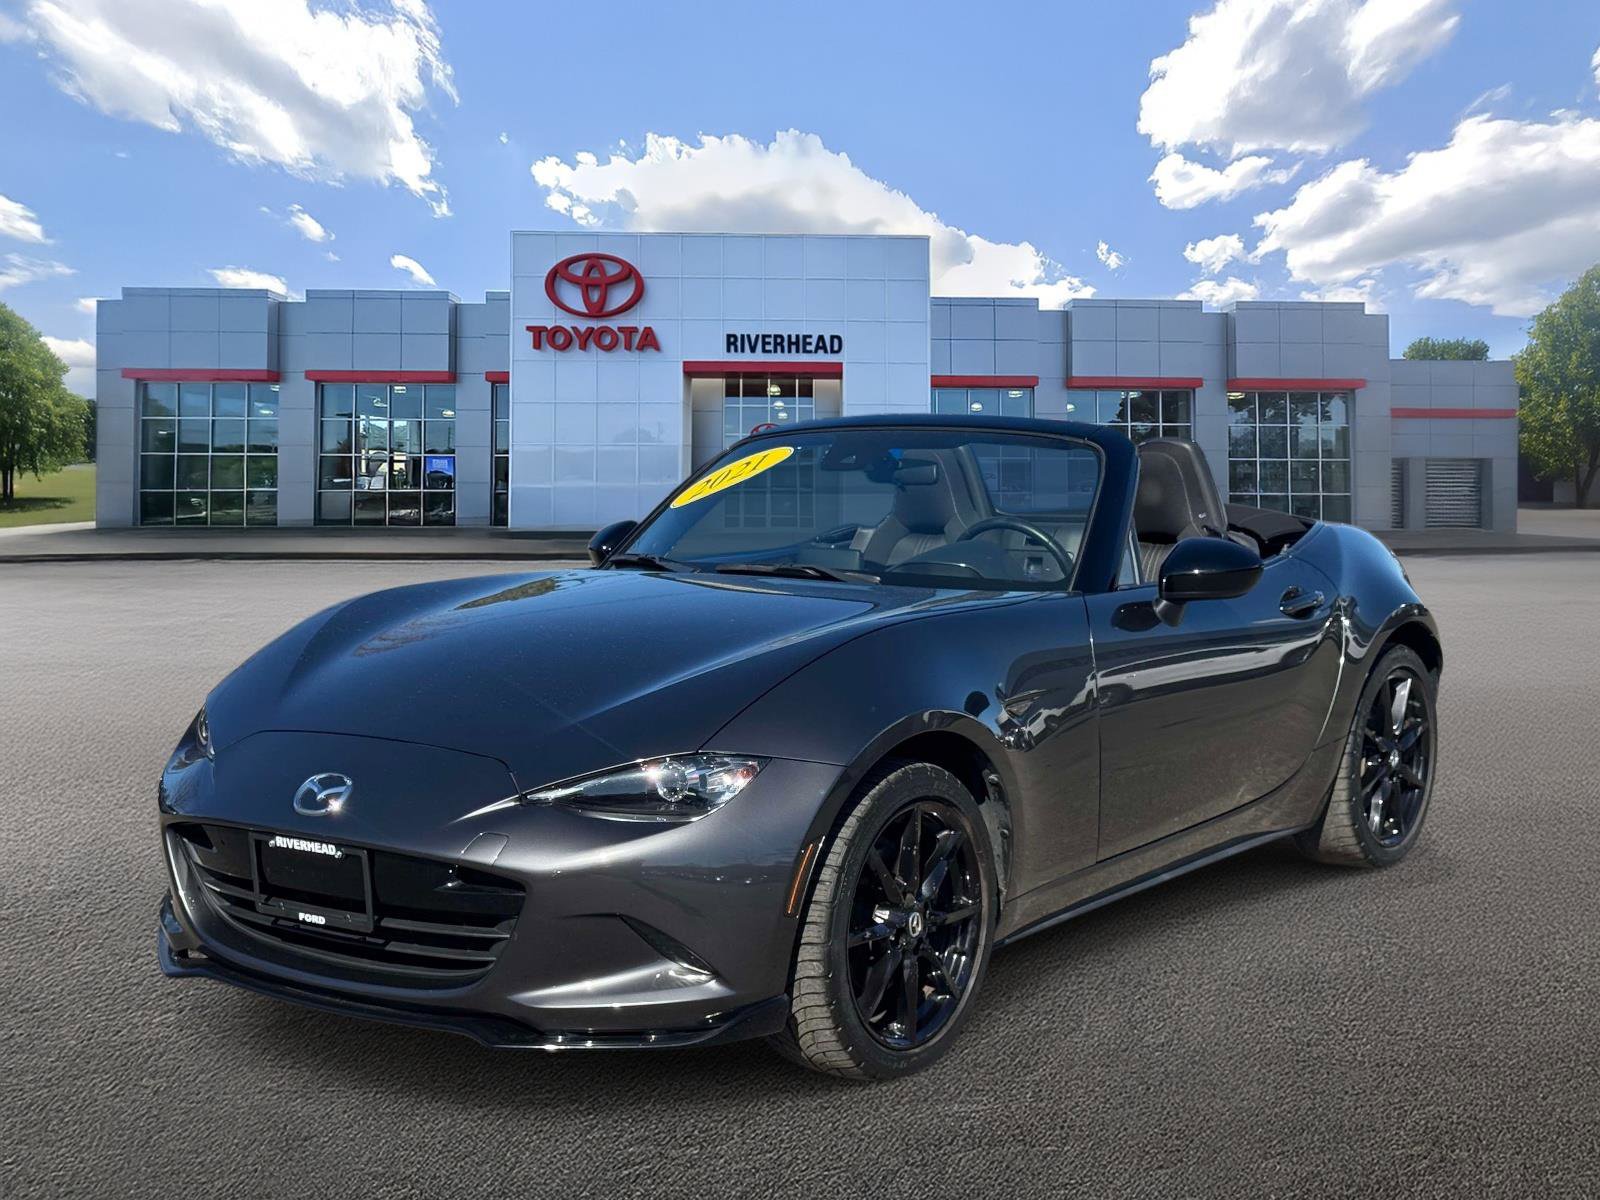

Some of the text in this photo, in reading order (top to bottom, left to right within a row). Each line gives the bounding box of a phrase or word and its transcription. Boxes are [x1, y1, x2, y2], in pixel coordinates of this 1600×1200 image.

[525, 325, 661, 352] TOYOTA
[726, 333, 843, 354] RIVERHEAD
[688, 453, 770, 501] 2021
[275, 835, 337, 856] RIVERHEAD
[298, 912, 326, 925] FORD
